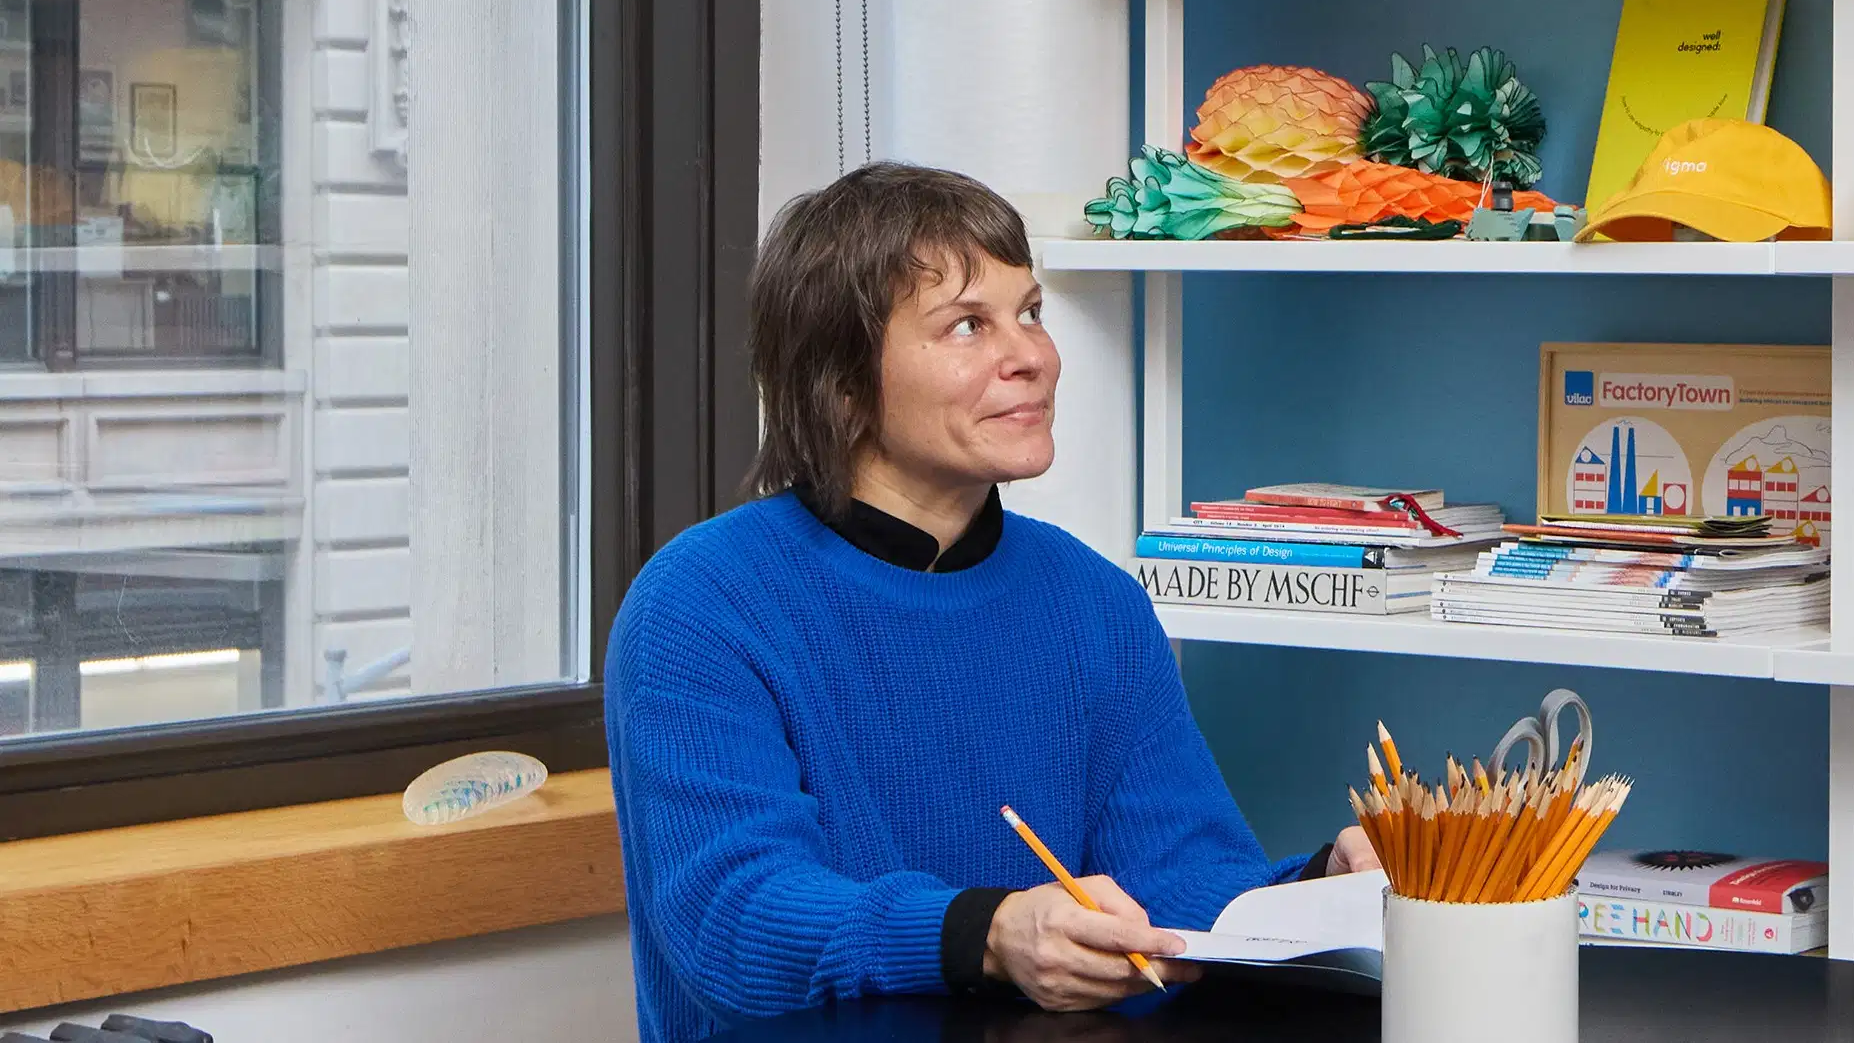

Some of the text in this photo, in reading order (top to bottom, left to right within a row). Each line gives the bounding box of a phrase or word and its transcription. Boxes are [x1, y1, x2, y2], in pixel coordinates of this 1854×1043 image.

[1702, 29, 1721, 41] well
[1677, 41, 1721, 55] designed:
[1158, 540, 1294, 560] Universal Principles of Design
[1138, 563, 1364, 608] MADE BY MSCHF
[1589, 881, 1641, 894] Design for Privacy
